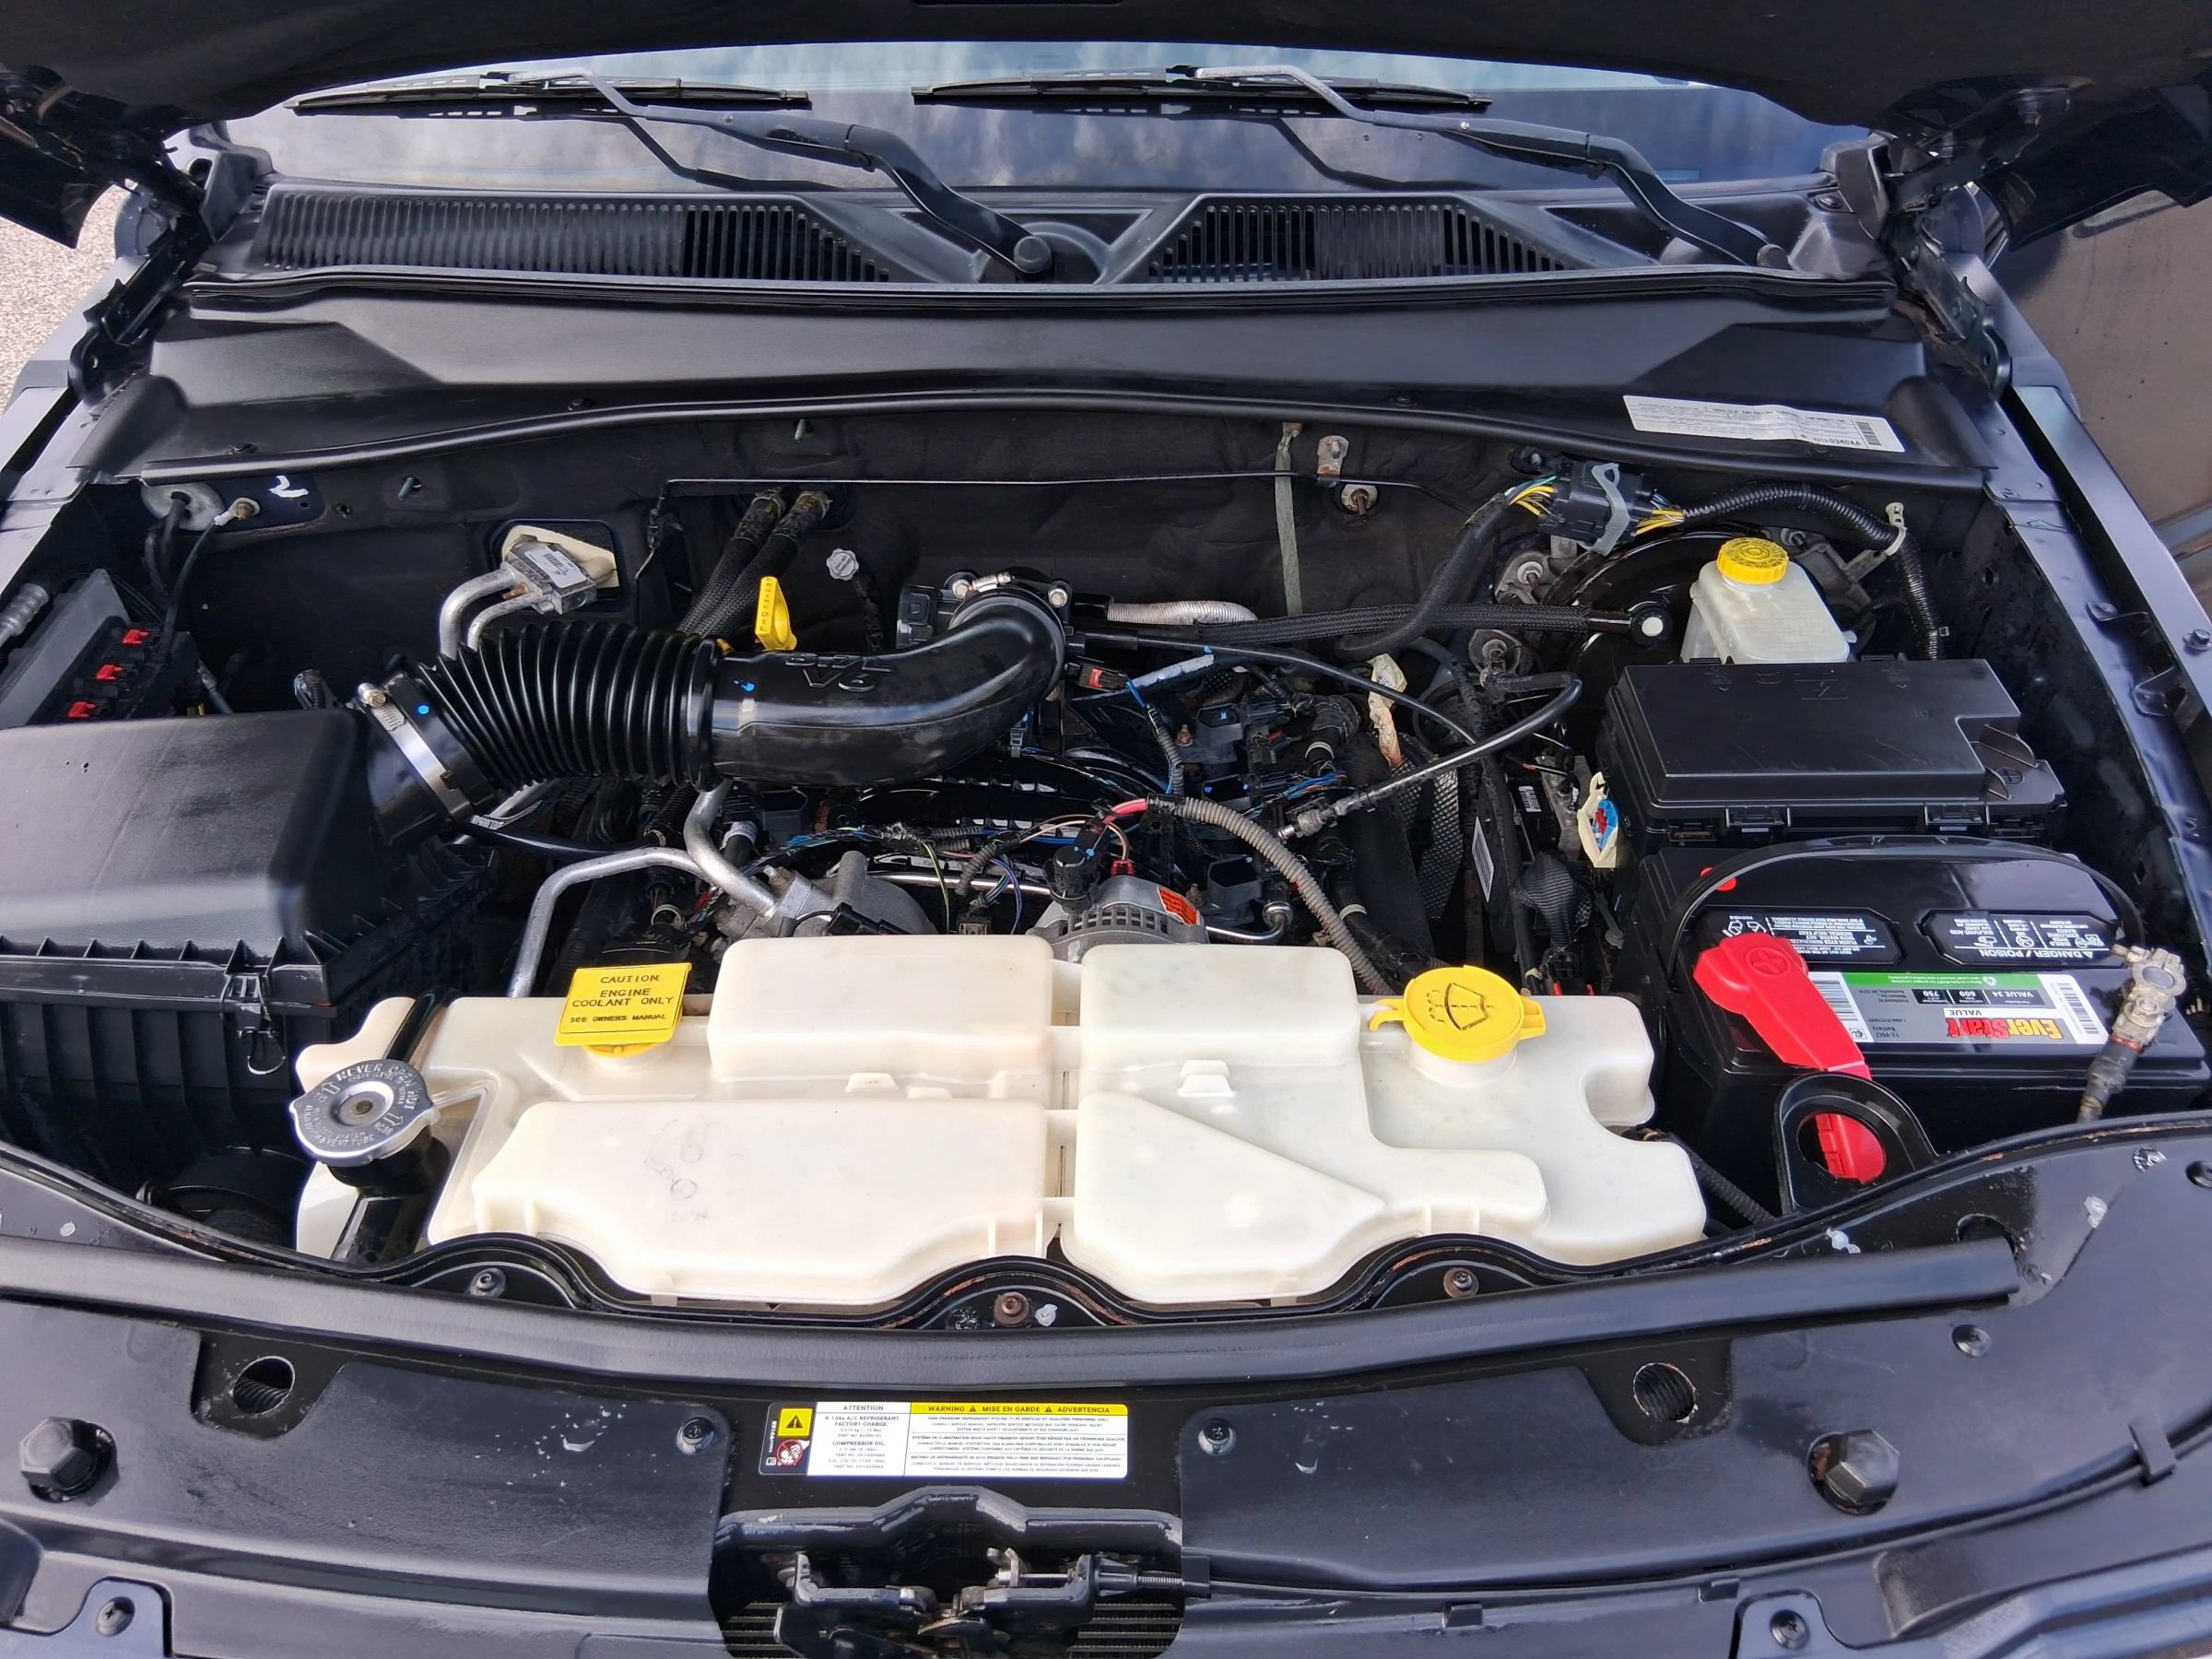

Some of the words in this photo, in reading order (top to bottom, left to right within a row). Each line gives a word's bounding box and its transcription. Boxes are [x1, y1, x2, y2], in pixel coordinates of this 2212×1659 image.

[803, 668, 877, 692] V6
[1979, 949, 2025, 958] POISON
[2035, 950, 2085, 959] DANGER
[600, 974, 660, 983] CAUTION
[599, 988, 652, 997] ENGINE
[571, 998, 632, 1007] COOLANT
[641, 996, 675, 1006] ONLY
[1946, 1018, 2064, 1040] EverStart
[335, 1063, 384, 1082] NEVER
[388, 1065, 418, 1087] OPEN
[349, 1134, 376, 1145] TUBE
